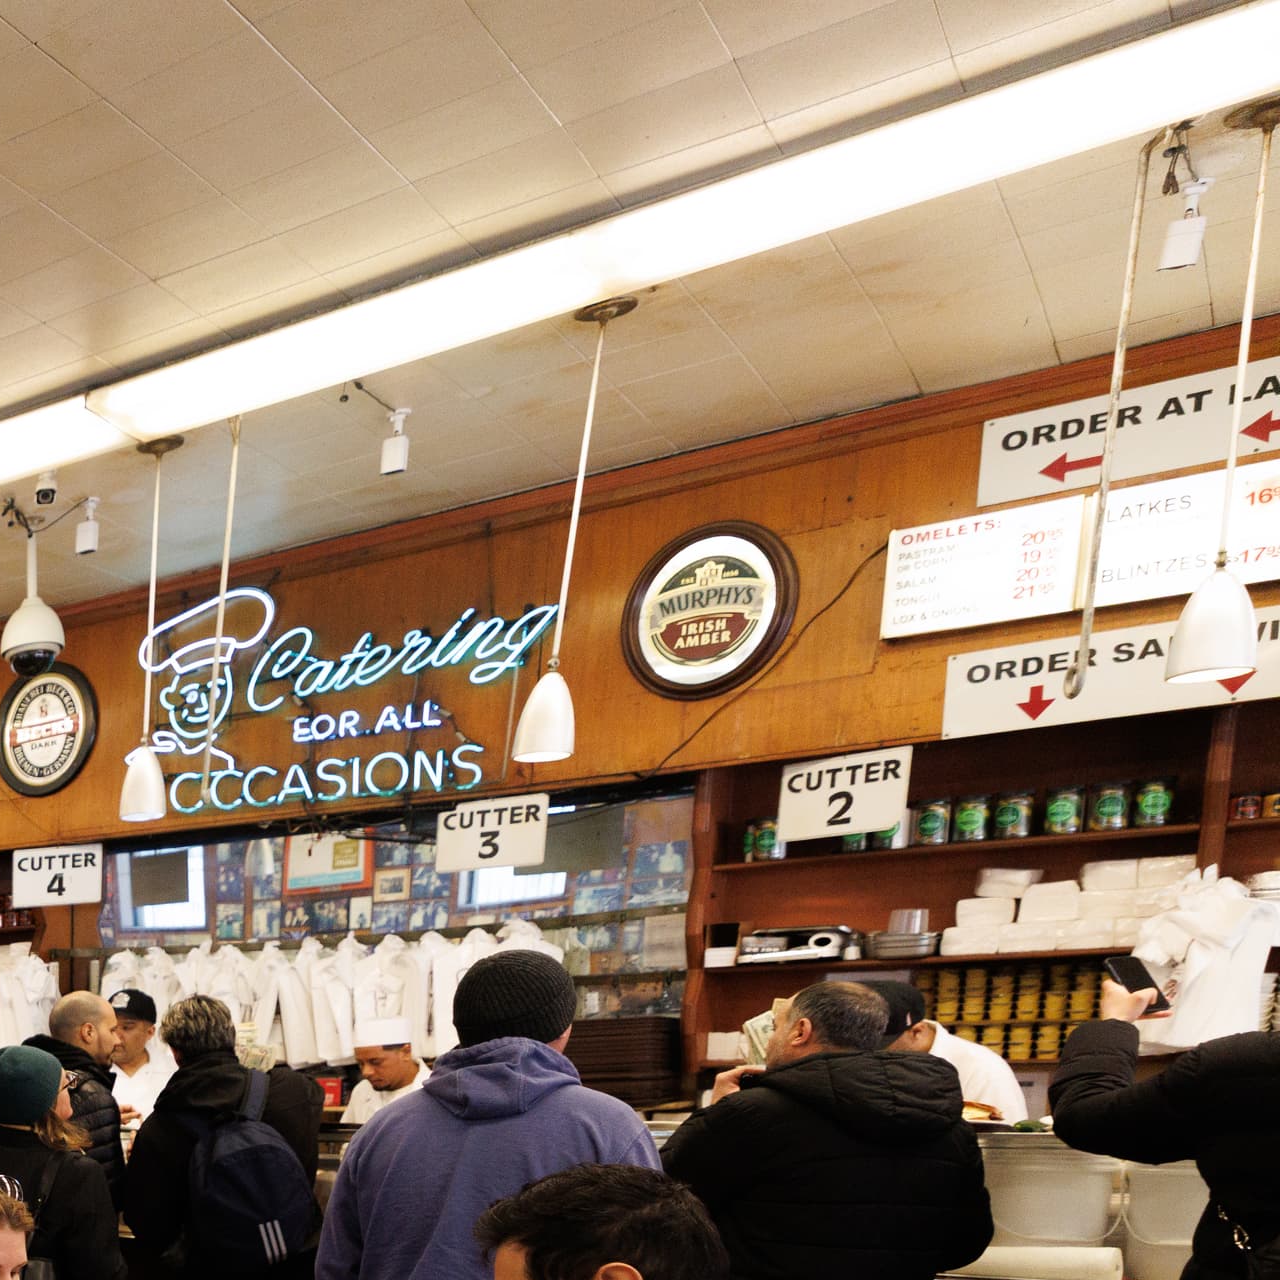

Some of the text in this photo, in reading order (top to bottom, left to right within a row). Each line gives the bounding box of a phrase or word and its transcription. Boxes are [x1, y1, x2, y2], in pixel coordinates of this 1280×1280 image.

[1001, 405, 1143, 451] ORDER
[1157, 389, 1214, 421] AT
[1107, 495, 1192, 523] LATKES
[900, 519, 1002, 547] OMELETS:
[1101, 552, 1208, 584] BLINTZES
[673, 630, 732, 650] AMBER
[681, 618, 727, 637] IRISH
[247, 602, 560, 712] Catering
[966, 648, 1097, 685] ORDER
[373, 699, 442, 734] ALL
[30, 739, 58, 752] DARK
[169, 743, 486, 813] OCCASIONS
[787, 759, 902, 794] CUTTER
[443, 803, 541, 831] CUTTER
[826, 790, 854, 827] 2
[477, 830, 500, 860] 3
[17, 851, 97, 873] CUTTER
[46, 872, 66, 897] 4
